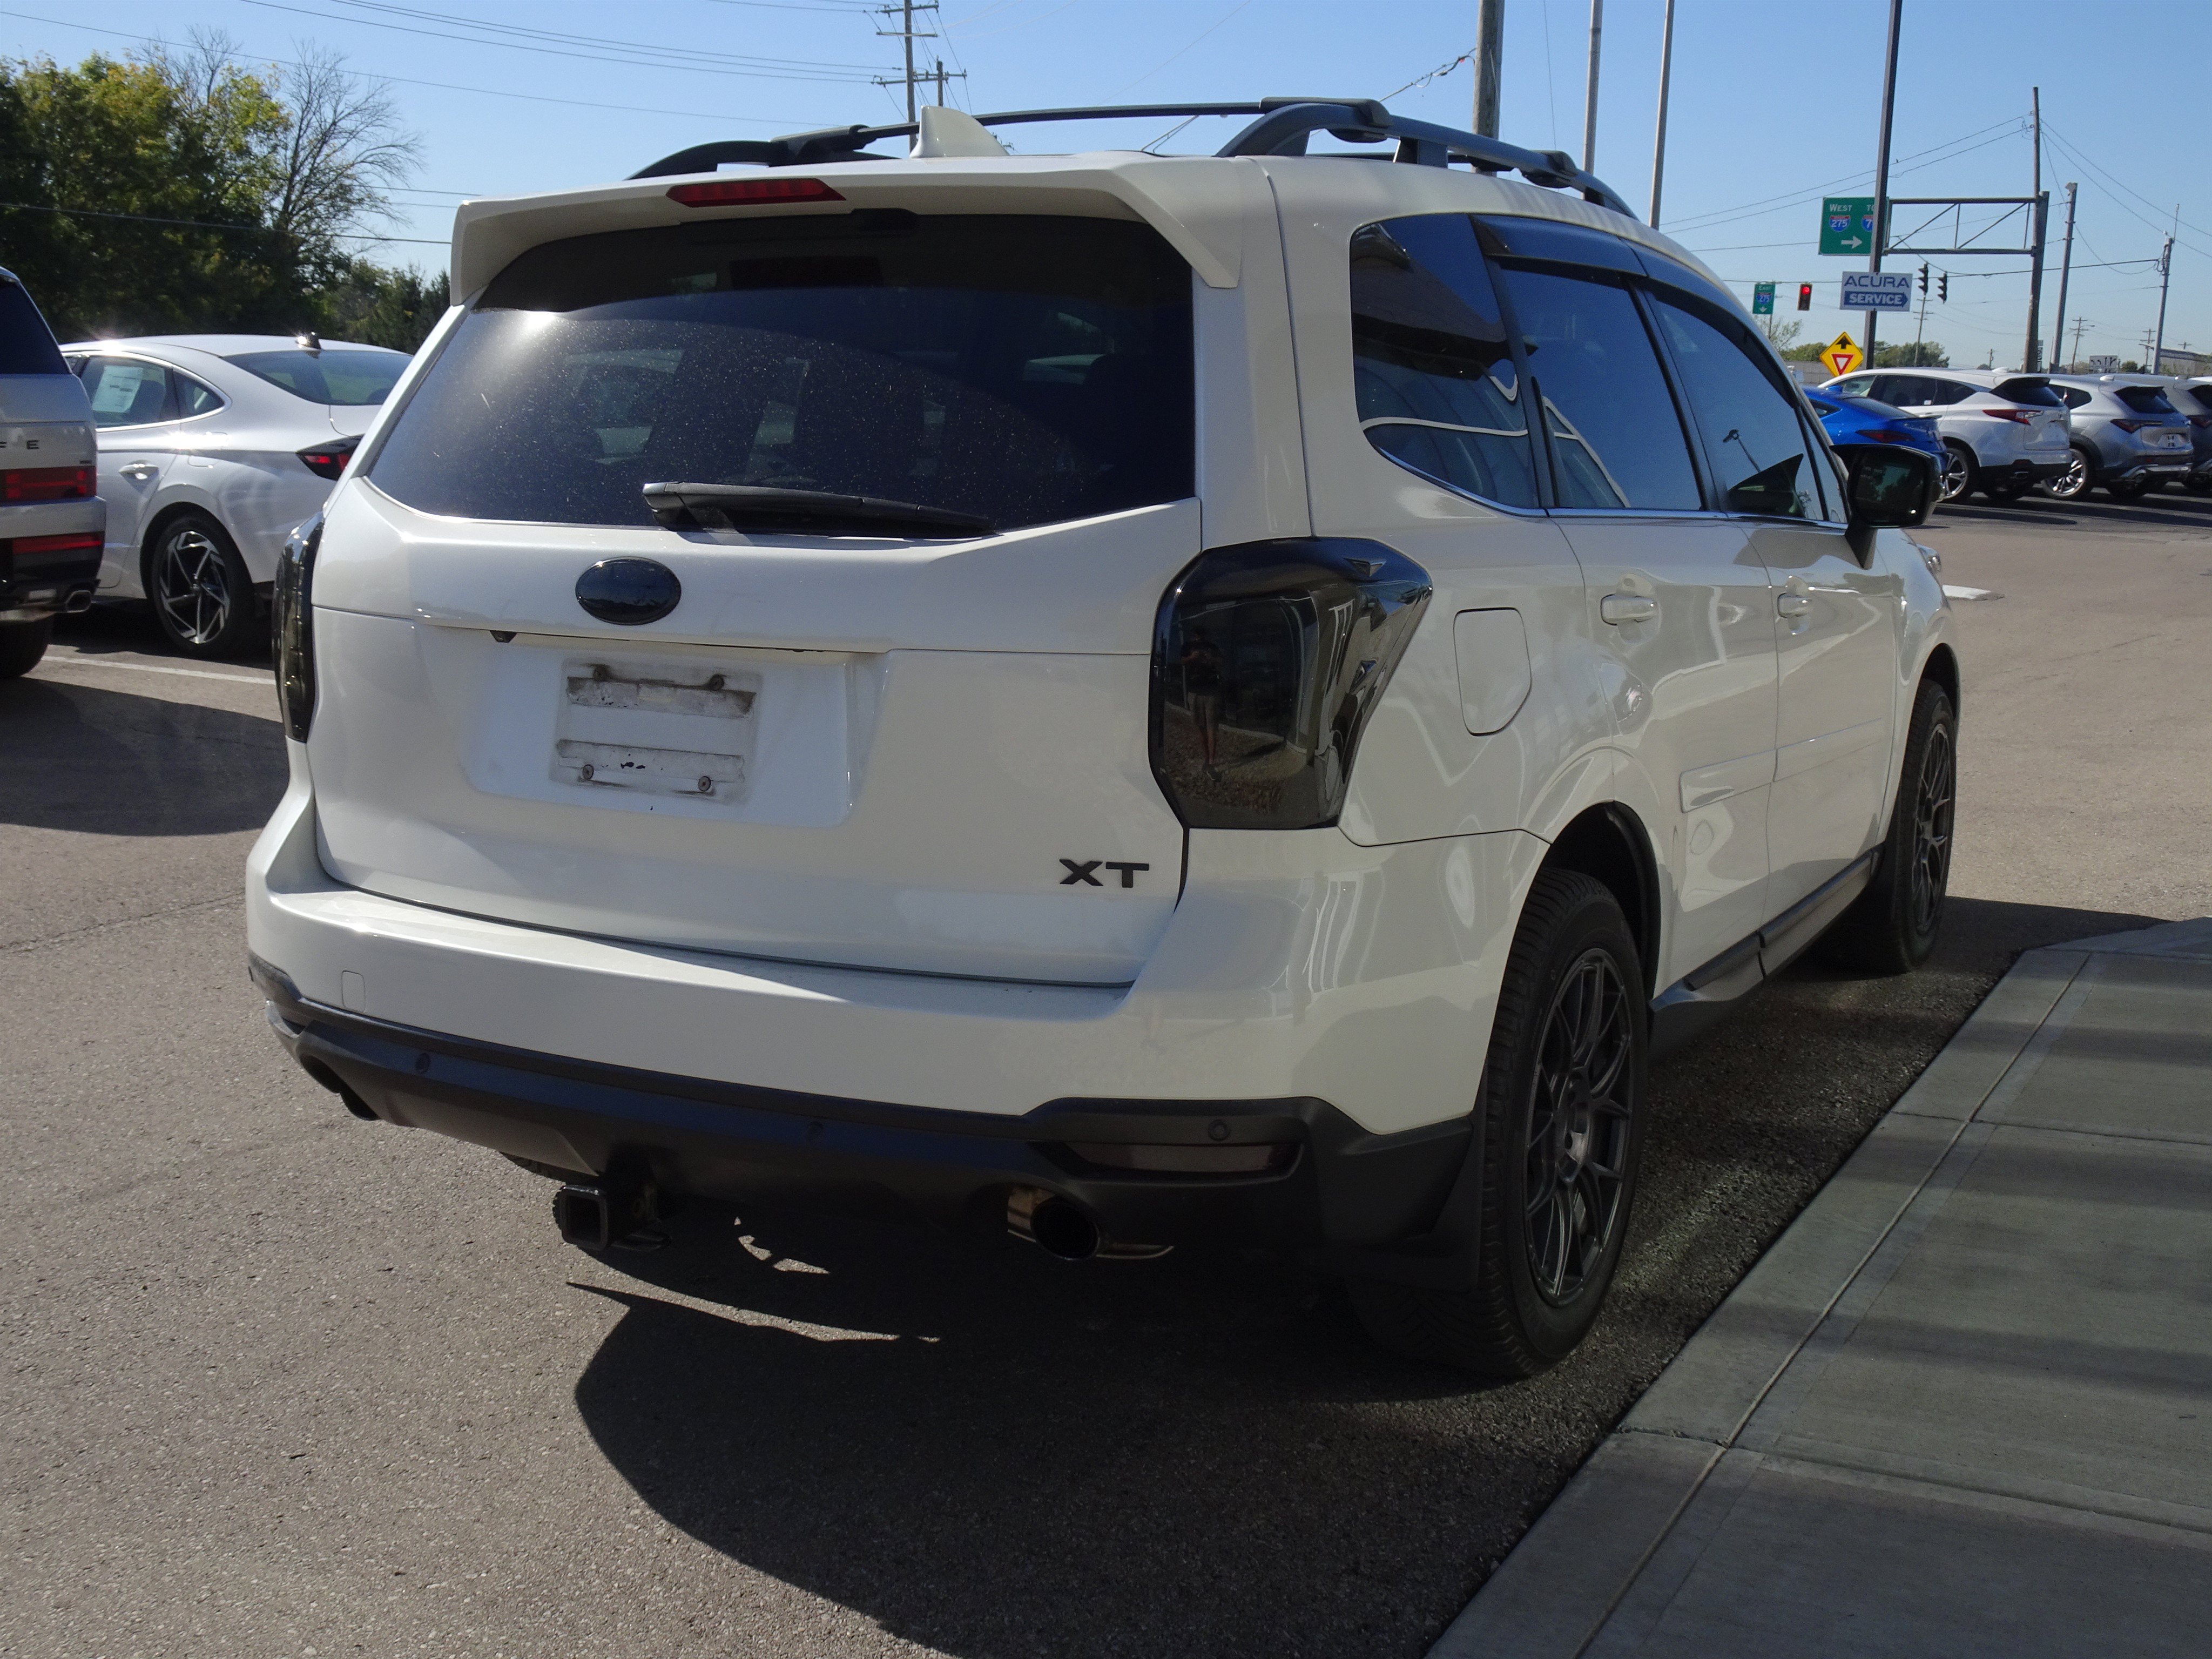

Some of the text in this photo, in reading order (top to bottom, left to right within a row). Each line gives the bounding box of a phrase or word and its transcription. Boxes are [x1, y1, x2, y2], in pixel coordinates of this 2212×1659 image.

[1831, 219, 1872, 228] 275 7
[1844, 275, 1910, 288] ACURA
[1849, 293, 1903, 305] SERVICE
[1059, 859, 1150, 888] XT
